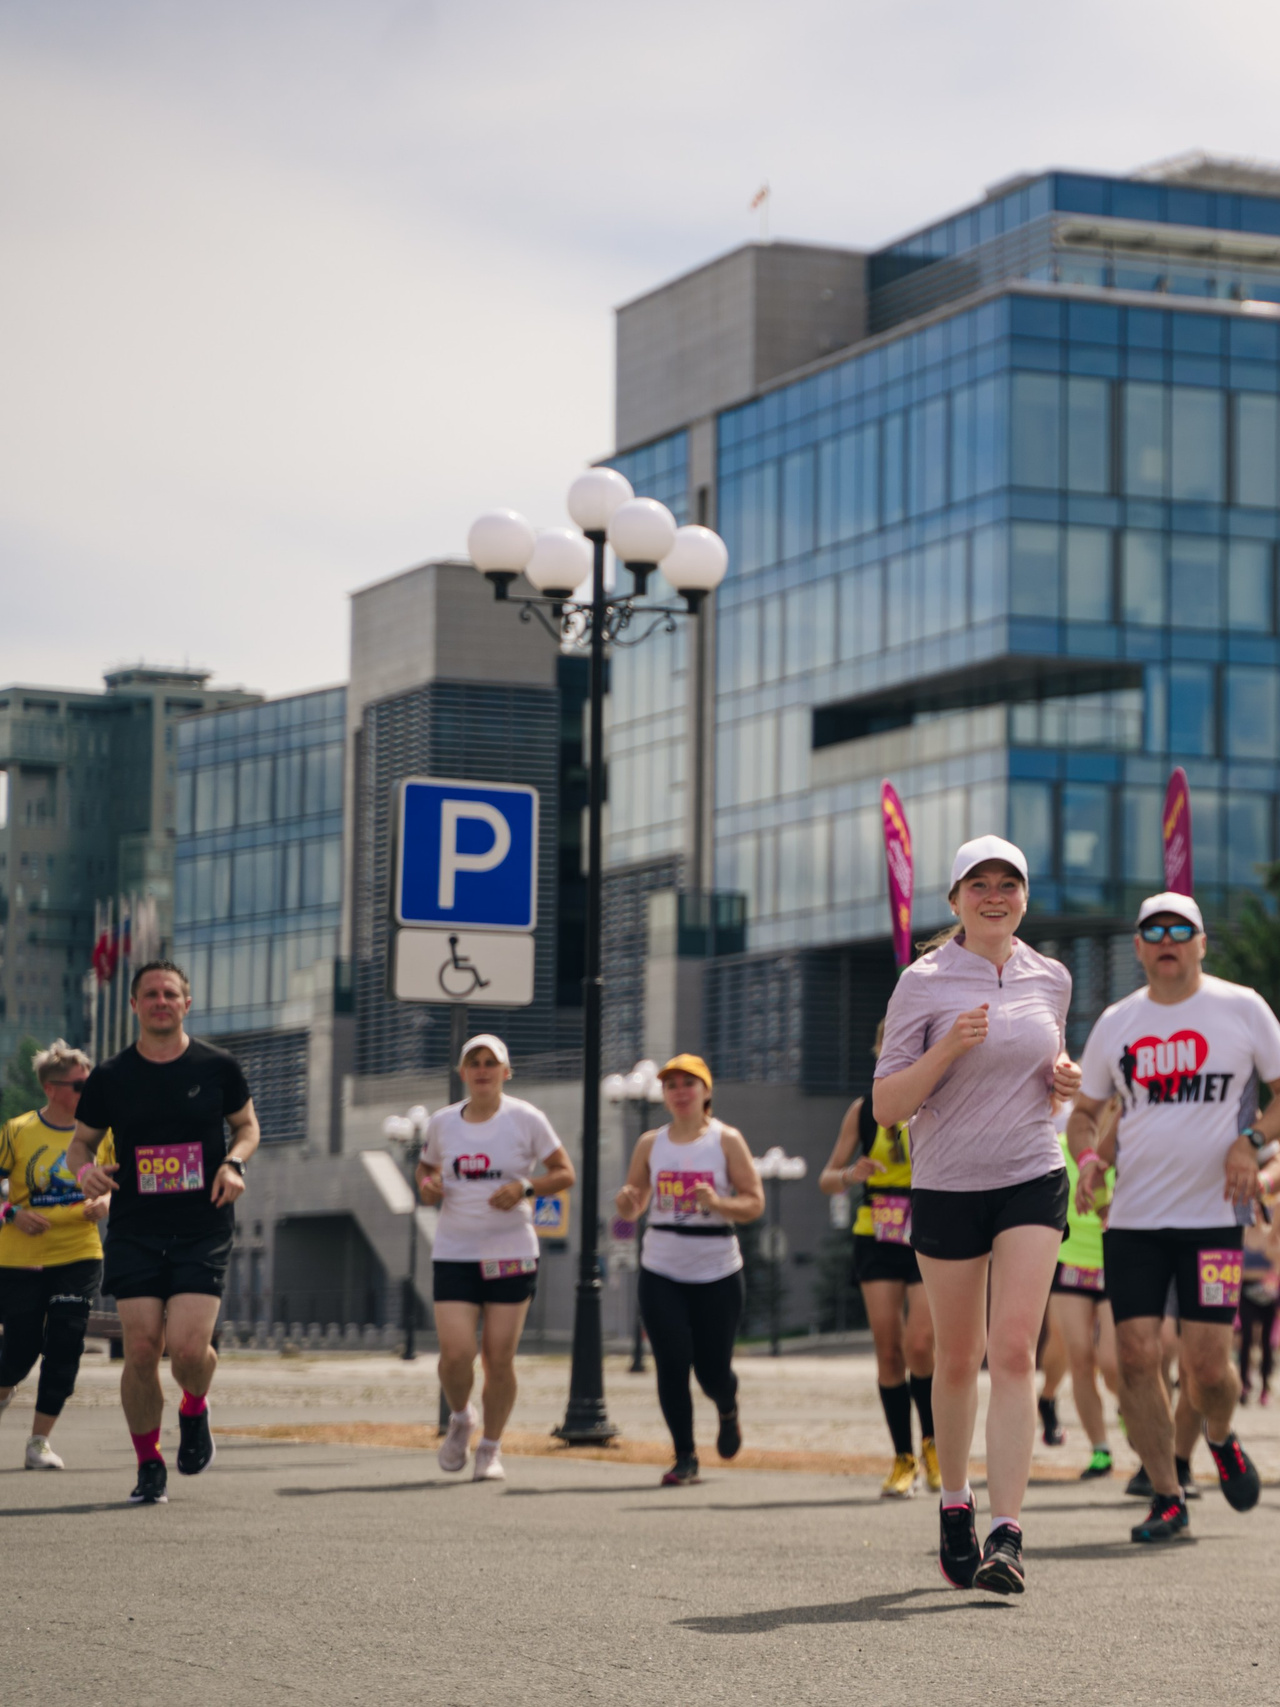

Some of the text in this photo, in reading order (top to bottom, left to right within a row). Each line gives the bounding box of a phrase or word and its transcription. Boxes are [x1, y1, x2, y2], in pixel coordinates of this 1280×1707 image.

[437, 798, 512, 910] P
[1136, 1038, 1197, 1079] RUN
[1147, 1072, 1235, 1105] ALMET
[138, 1156, 180, 1174] 050
[460, 1157, 486, 1172] RUN
[658, 1180, 684, 1197] 116
[1200, 1264, 1242, 1284] 049
